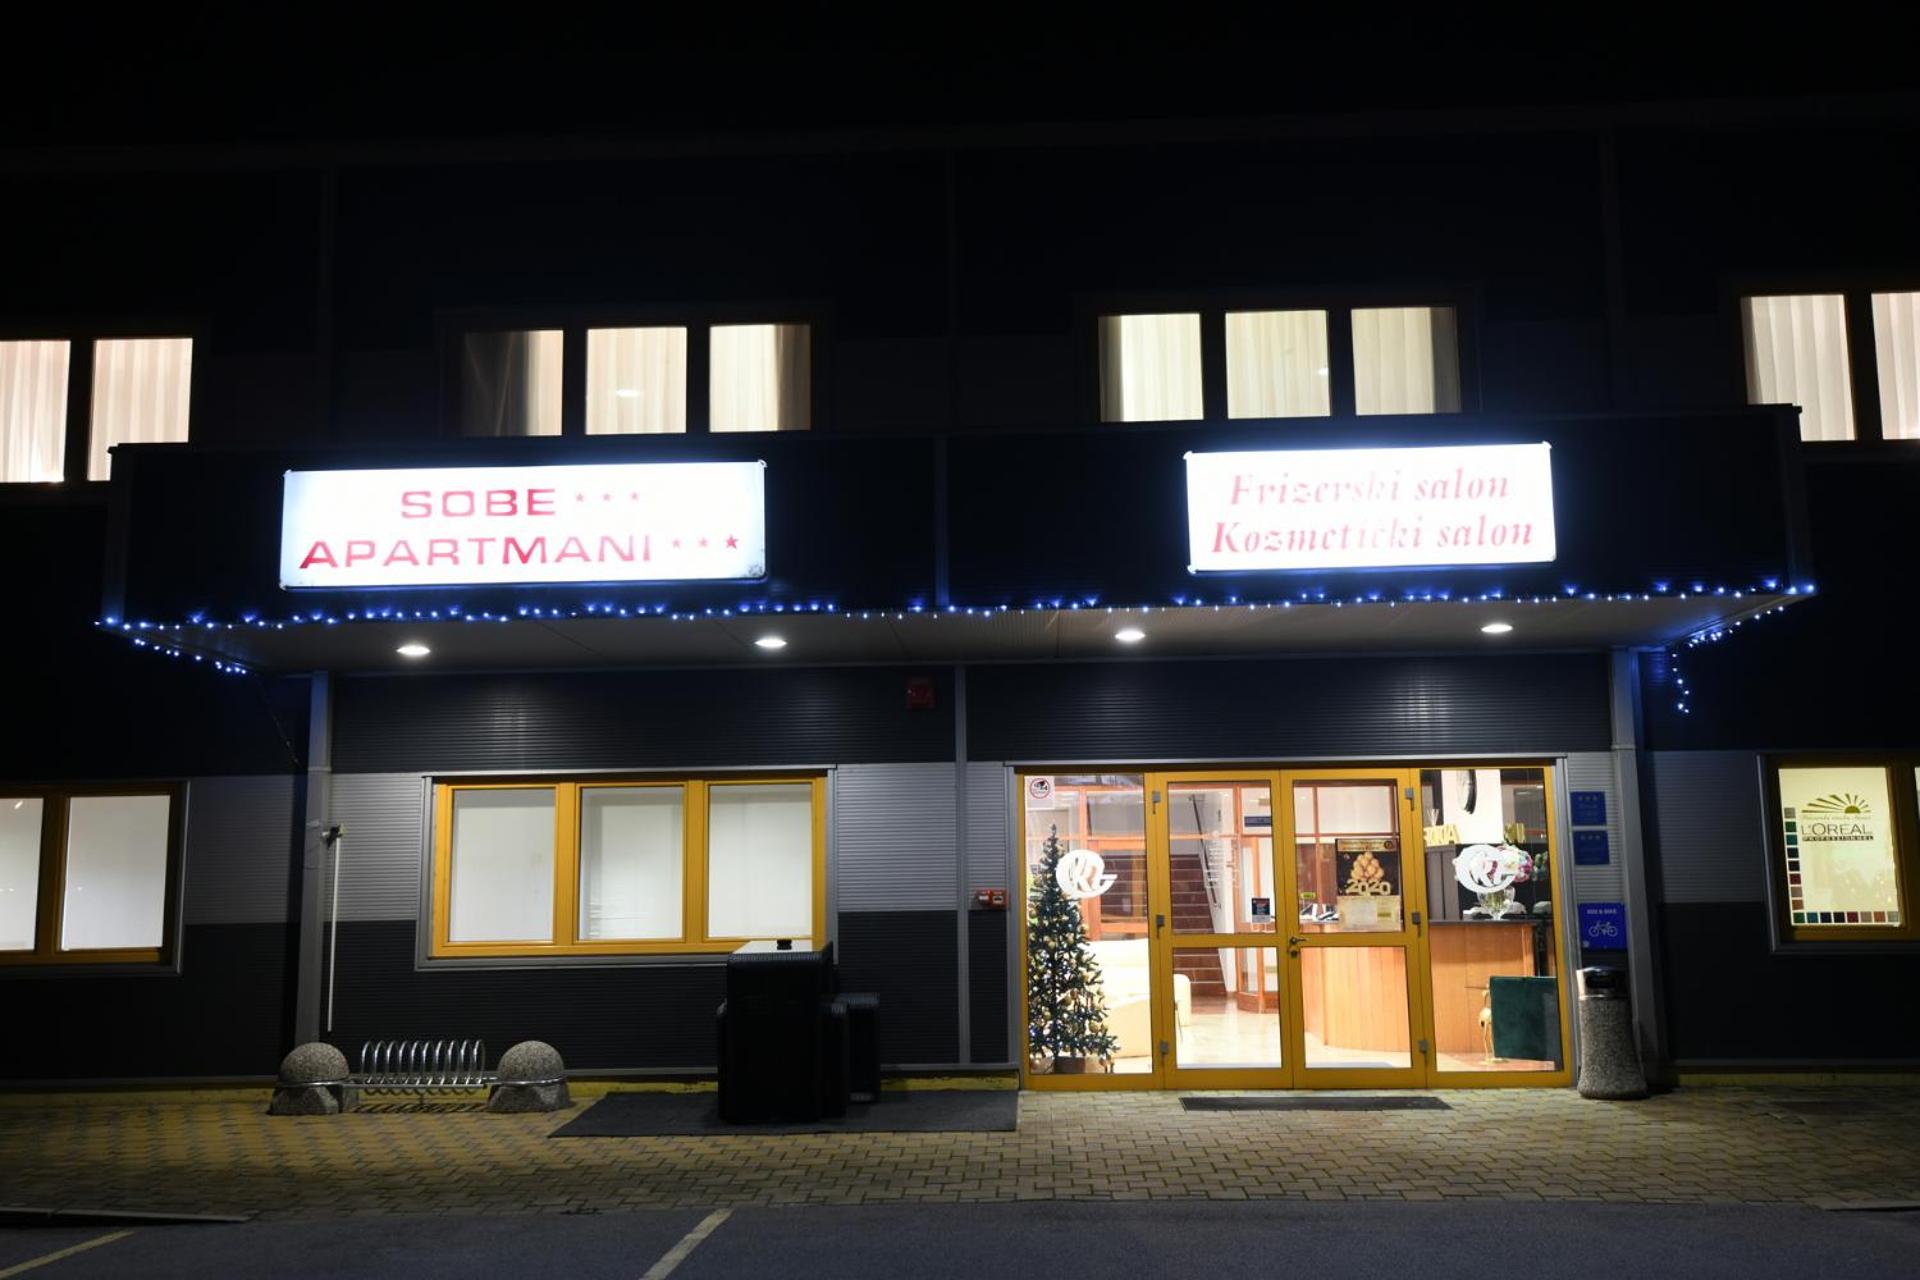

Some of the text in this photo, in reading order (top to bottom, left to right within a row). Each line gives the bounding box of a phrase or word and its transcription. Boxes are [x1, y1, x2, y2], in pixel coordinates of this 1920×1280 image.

[400, 487, 556, 519] SOBE
[1230, 466, 1511, 505] Frizerski salon
[1436, 513, 1534, 549] salon
[298, 534, 652, 570] APARTMANI
[1345, 879, 1391, 896] 2020
